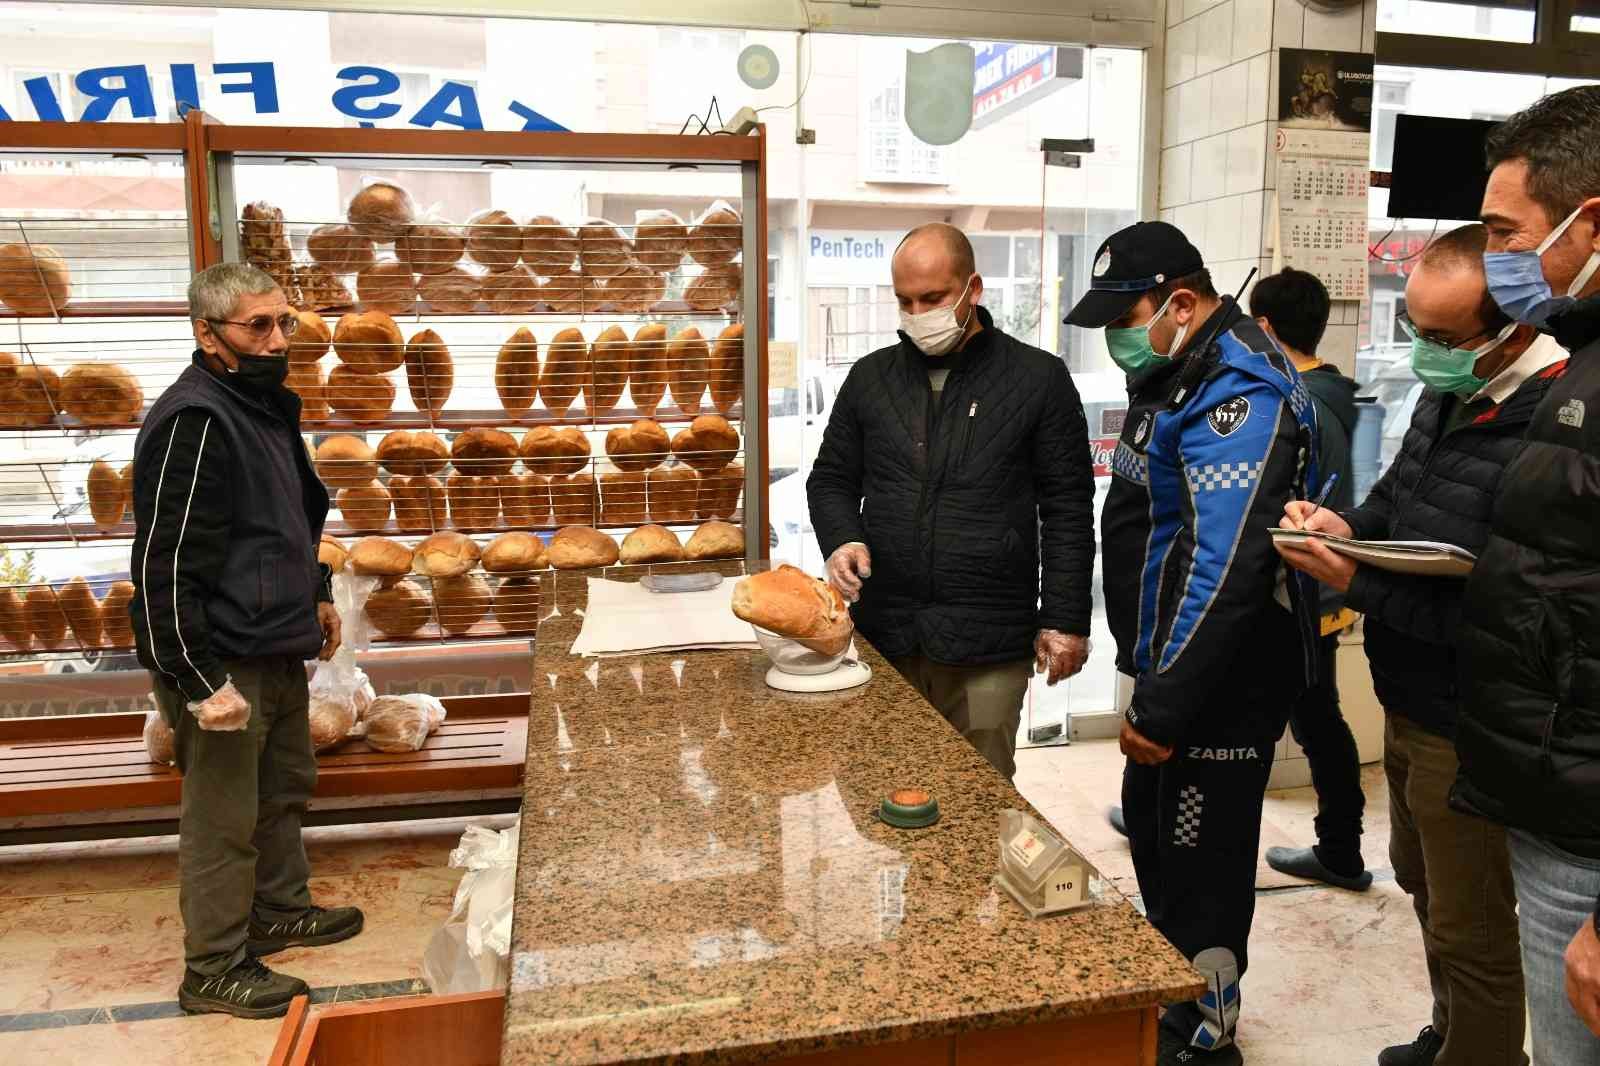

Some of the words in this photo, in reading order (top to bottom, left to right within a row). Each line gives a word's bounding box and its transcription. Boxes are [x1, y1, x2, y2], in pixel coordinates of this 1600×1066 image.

[810, 236, 884, 258] PenTech
[1187, 746, 1258, 761] ZABITA
[1056, 882, 1073, 892] 110
